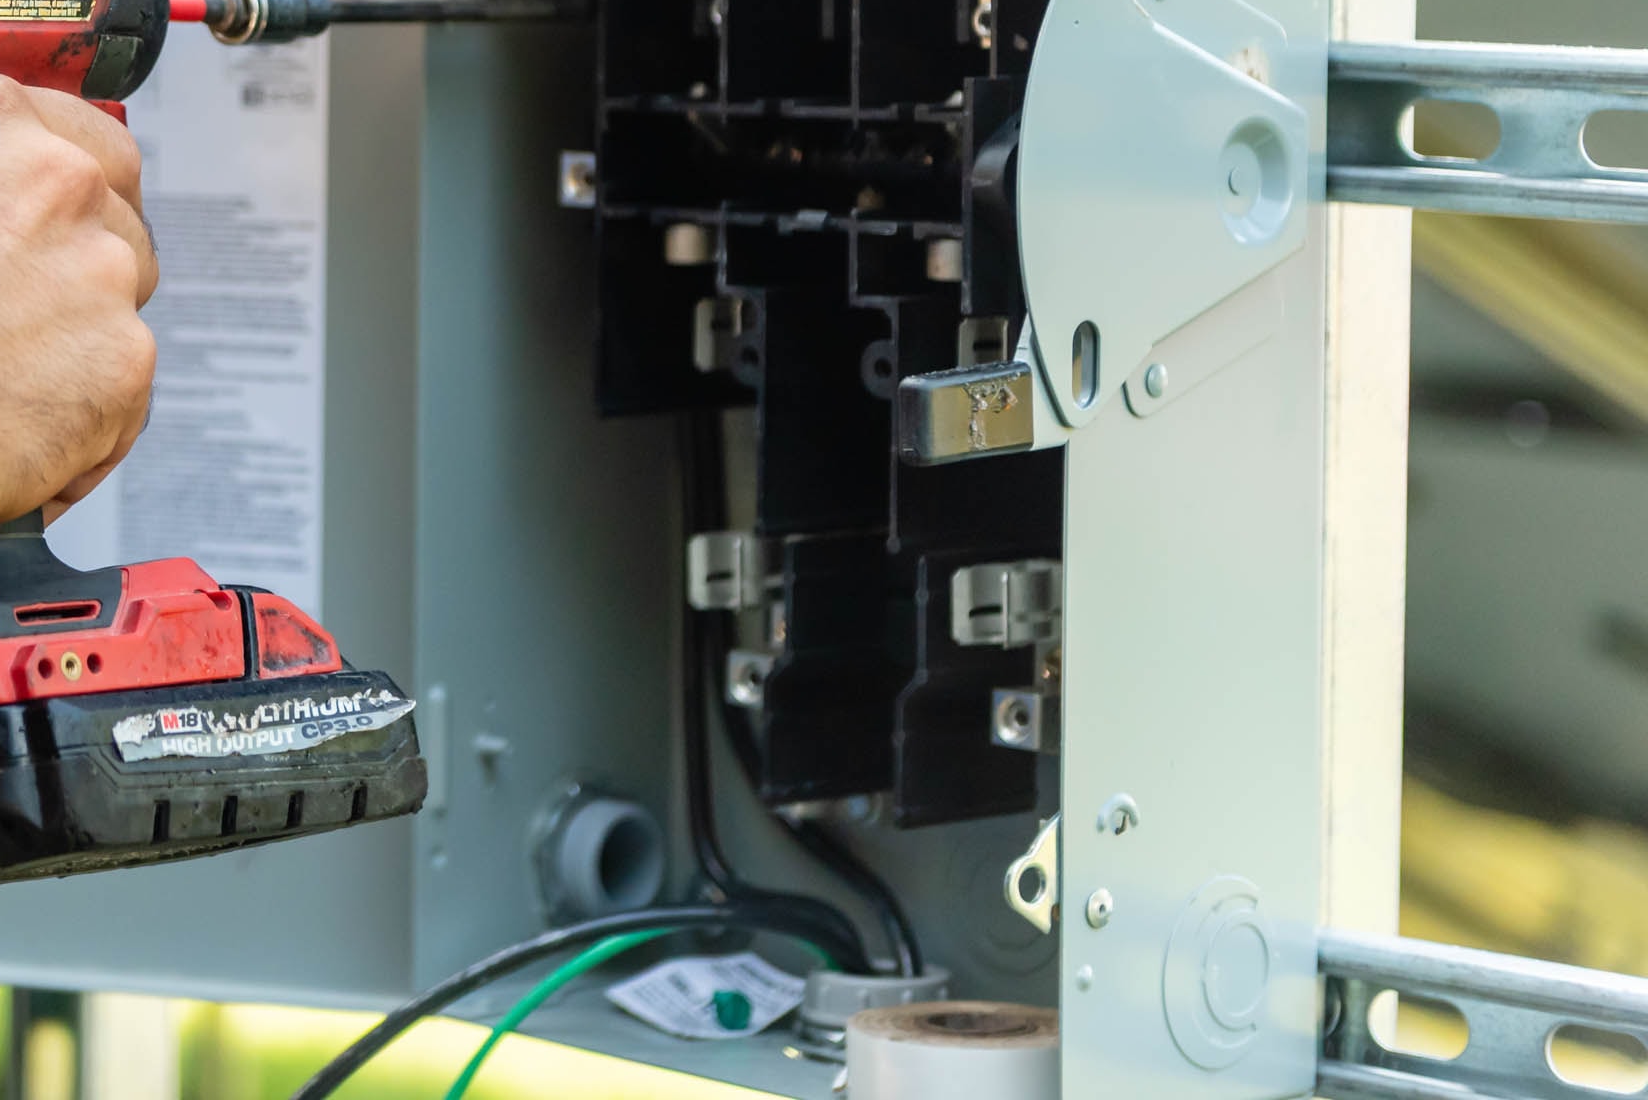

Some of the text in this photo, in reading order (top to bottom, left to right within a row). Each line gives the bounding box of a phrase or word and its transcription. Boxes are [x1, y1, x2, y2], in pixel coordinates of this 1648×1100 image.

[163, 712, 198, 729] M18
[162, 716, 374, 756] HIGH OUTPUT CP3.0
